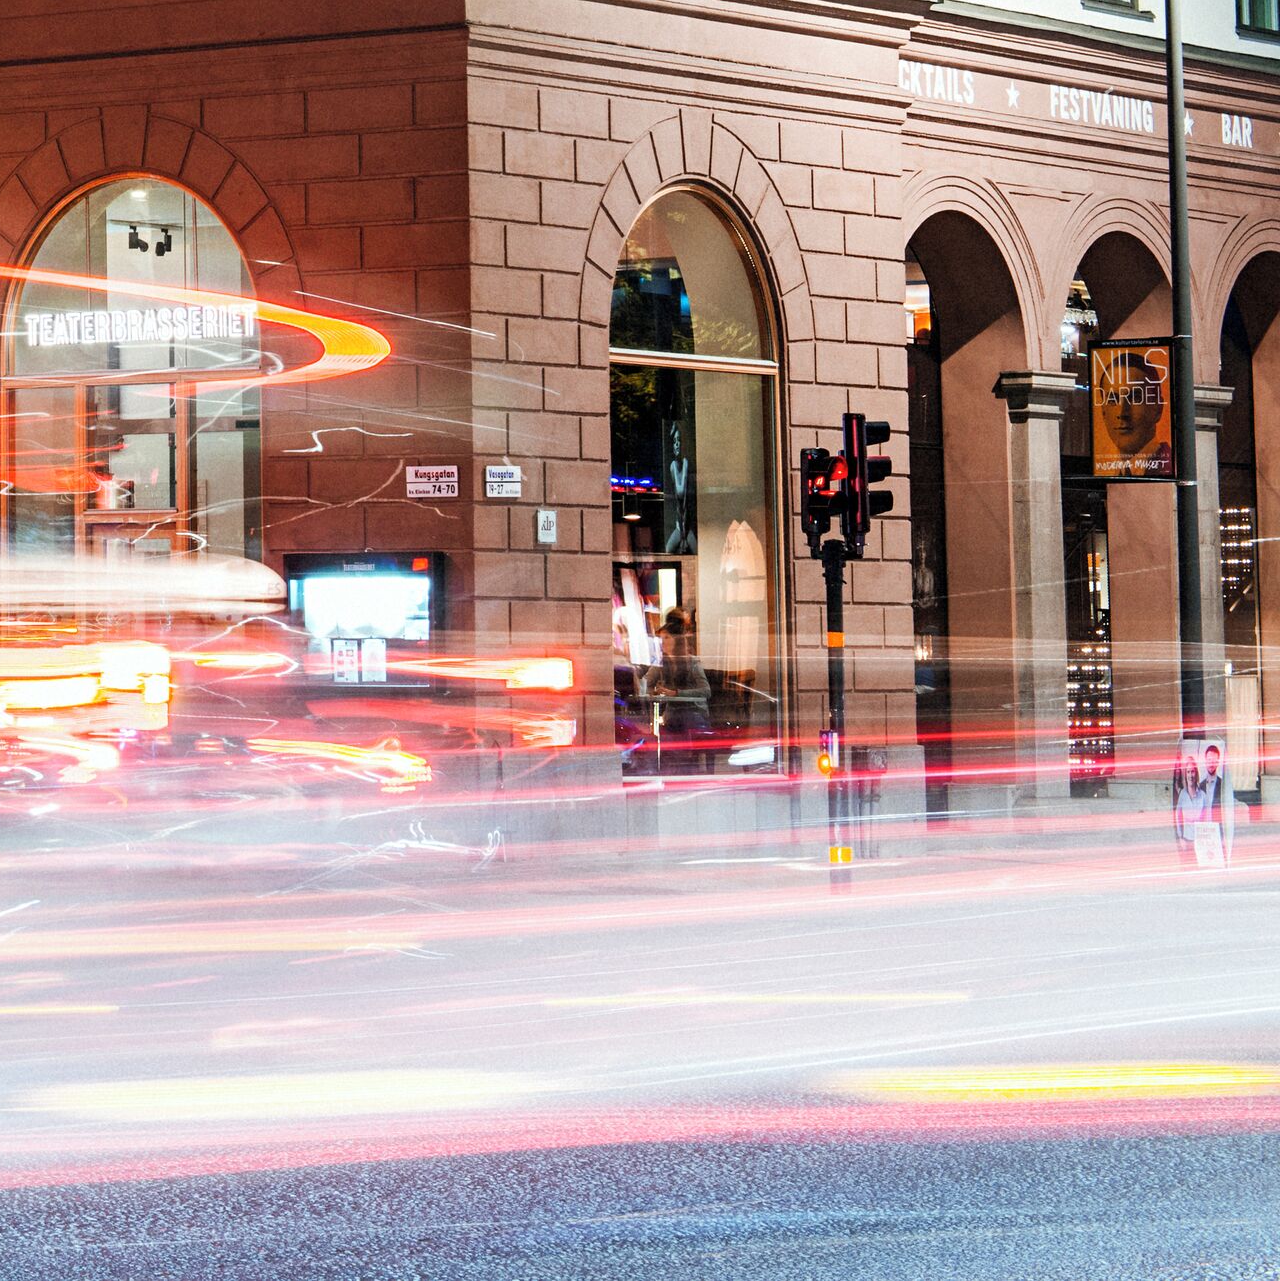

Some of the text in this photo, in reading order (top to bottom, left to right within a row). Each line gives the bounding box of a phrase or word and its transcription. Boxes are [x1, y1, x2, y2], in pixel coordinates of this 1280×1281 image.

[1221, 113, 1253, 149] BAR
[25, 303, 258, 346] TEATERBRASSERIET
[1093, 348, 1168, 385] NILS
[1093, 386, 1168, 406] DARDEL
[414, 469, 455, 481] Kungsgatan
[488, 469, 514, 481] Vasagatan
[432, 484, 456, 494] 74-70
